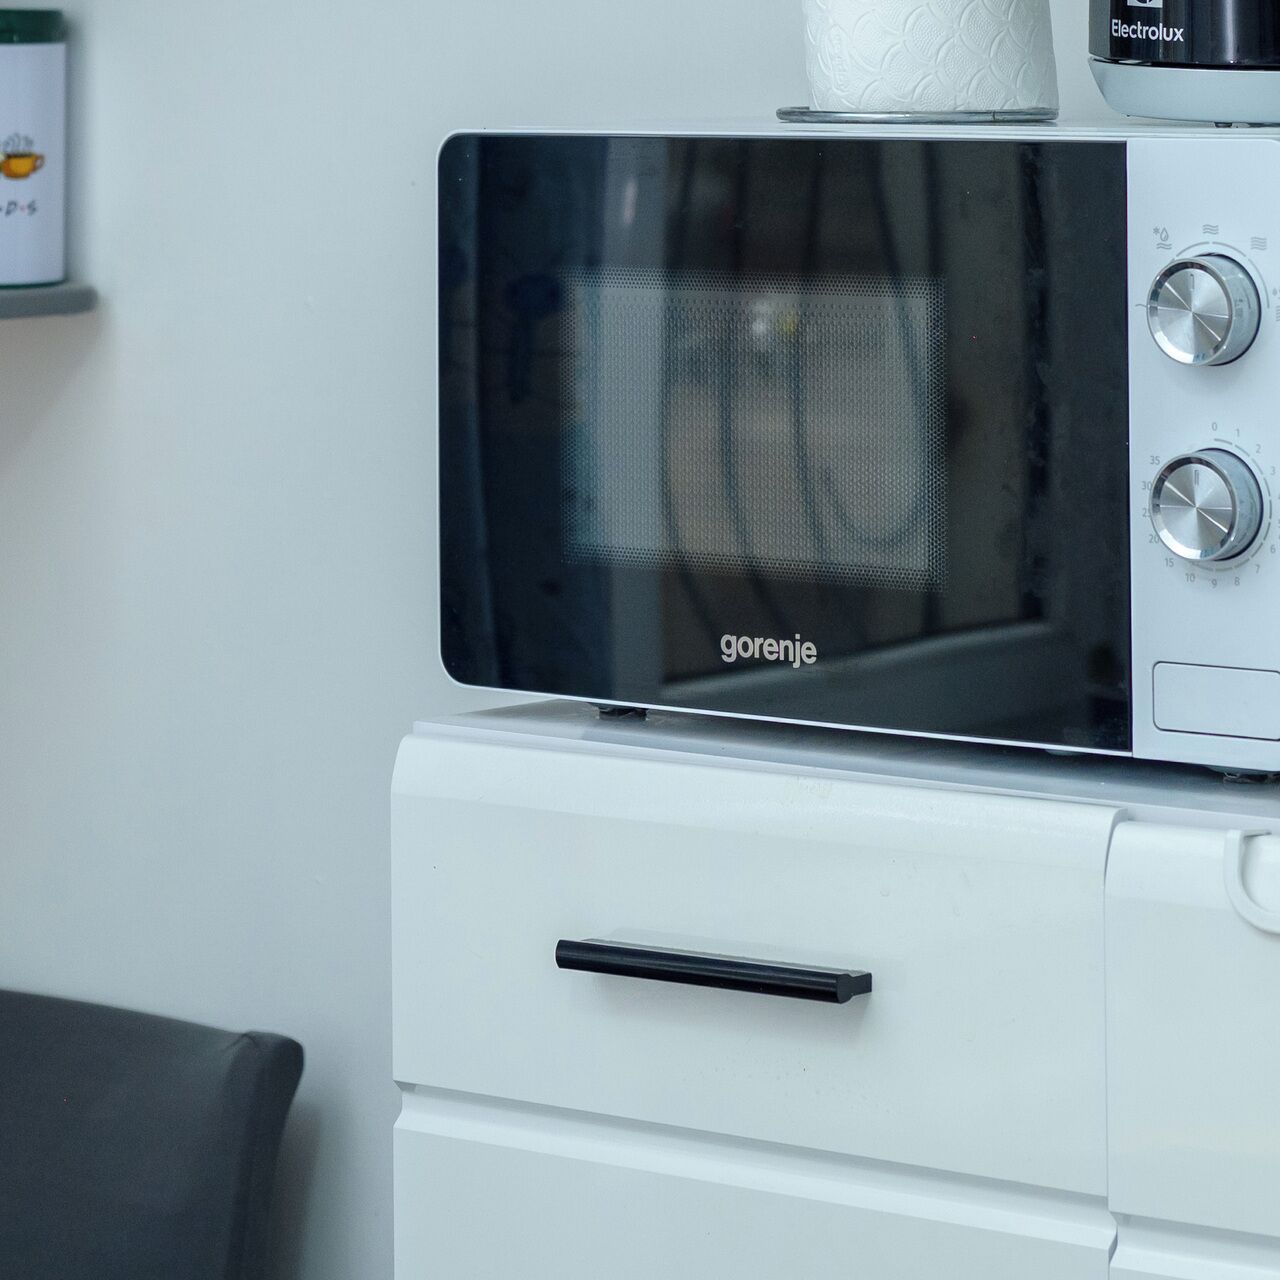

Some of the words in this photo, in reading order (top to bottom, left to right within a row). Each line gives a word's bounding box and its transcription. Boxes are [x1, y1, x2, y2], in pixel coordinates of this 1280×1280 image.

[1111, 18, 1185, 42] Electrolux
[1211, 422, 1218, 432] 0
[1235, 428, 1240, 438] 1
[1255, 444, 1261, 454] 2
[1150, 455, 1161, 466] 35
[1270, 466, 1276, 476] 3
[1141, 481, 1152, 491] 30
[1148, 534, 1160, 544] 20
[1270, 545, 1276, 554] 6
[1164, 558, 1175, 568] 15
[1255, 564, 1261, 574] 7
[1185, 573, 1196, 583] 10
[1234, 577, 1241, 586] 8
[1211, 579, 1218, 589] 9
[720, 633, 818, 669] gorenje
